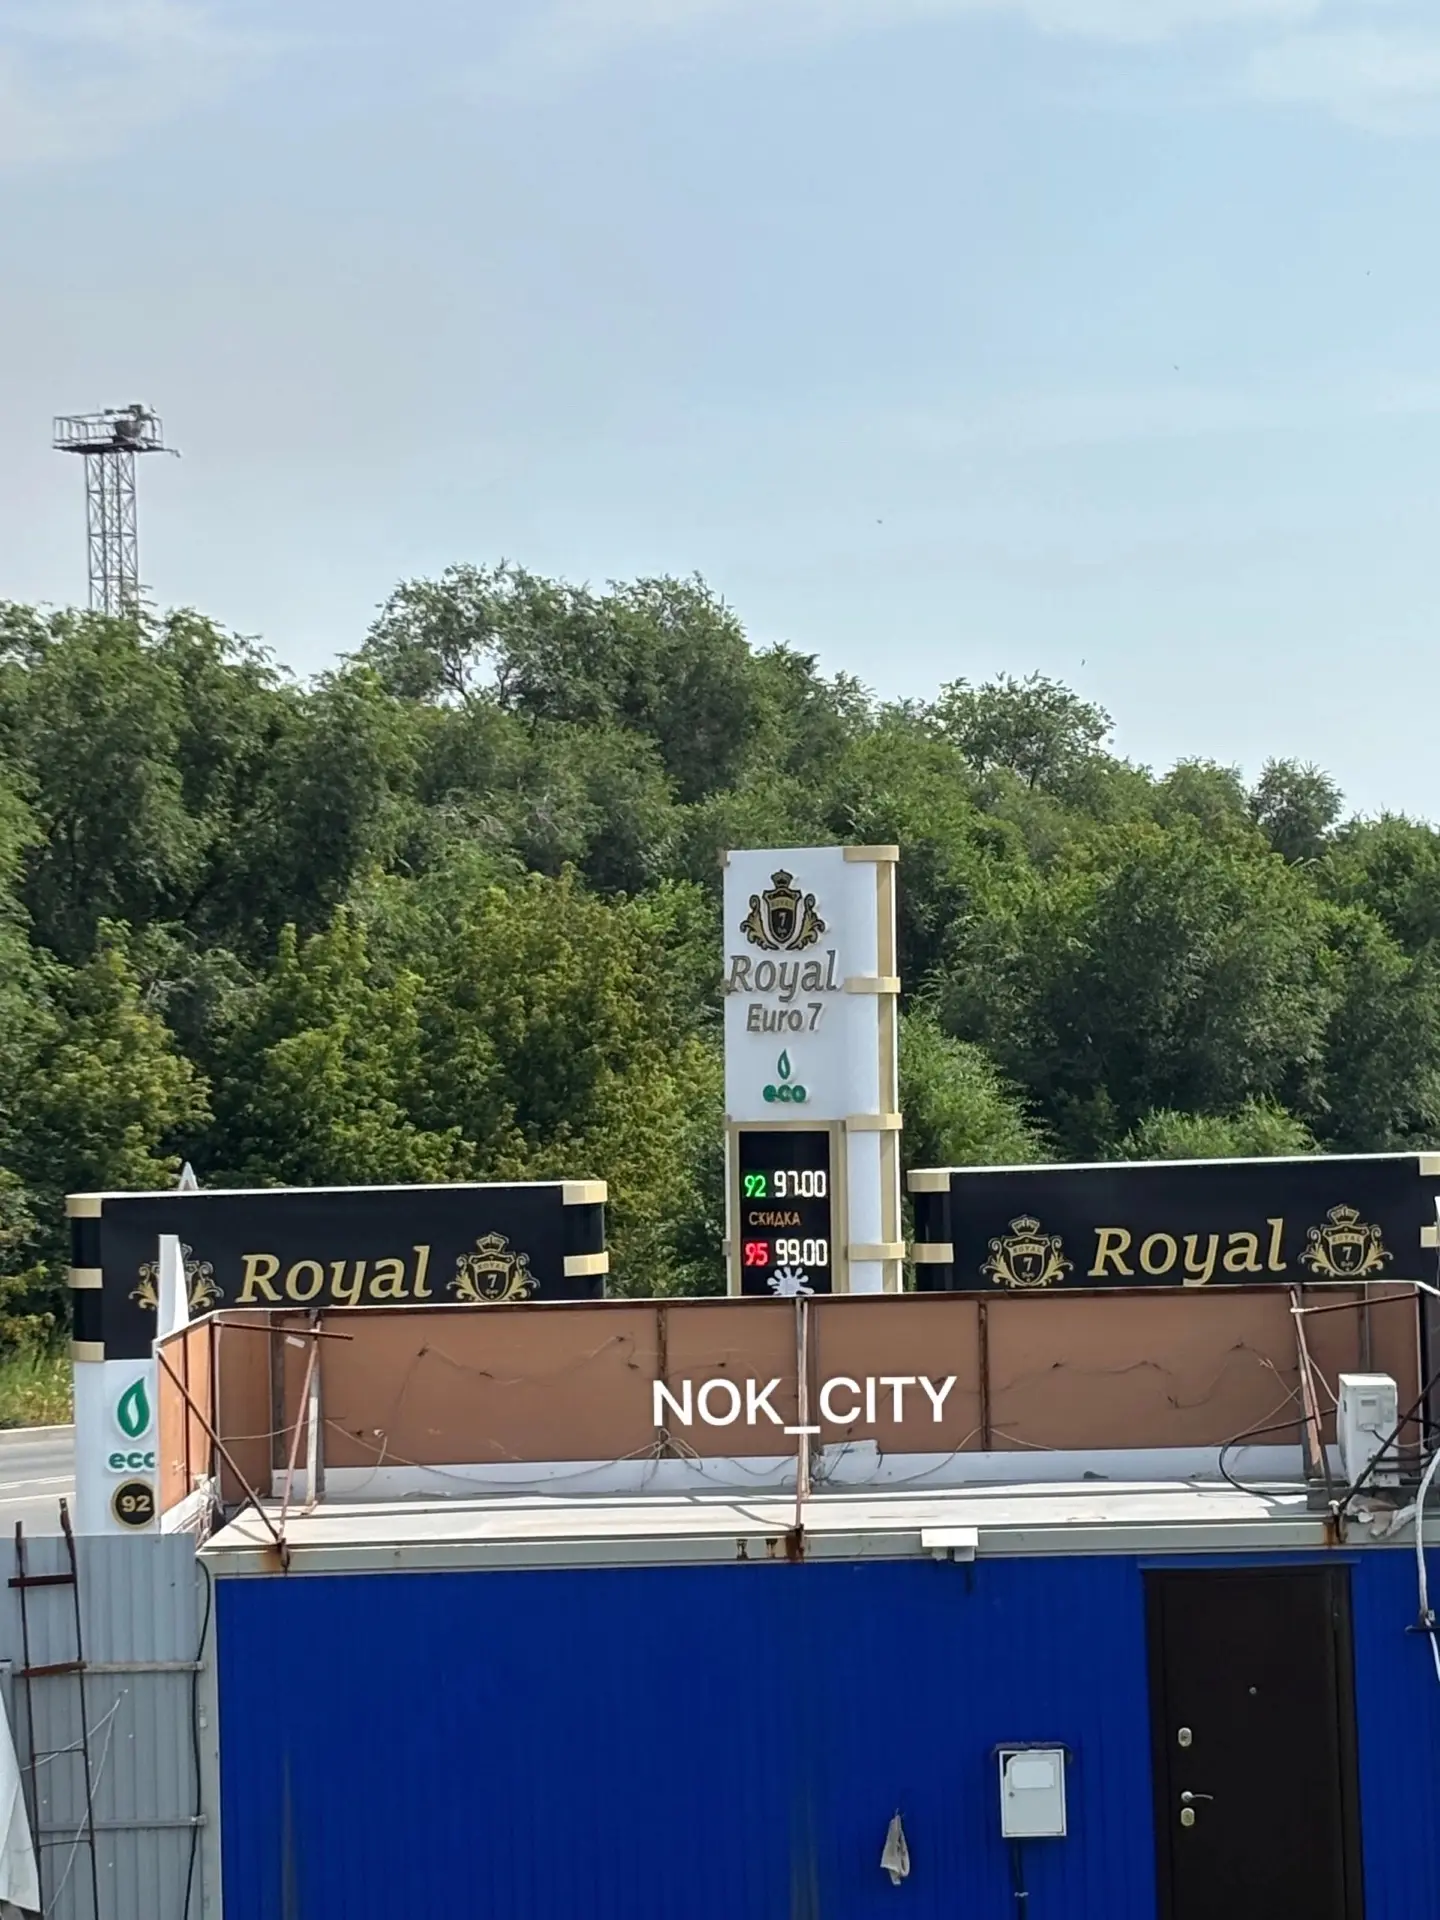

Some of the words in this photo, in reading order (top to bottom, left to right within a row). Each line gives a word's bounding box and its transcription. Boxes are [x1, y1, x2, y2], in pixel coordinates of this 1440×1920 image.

[778, 912, 788, 928] 7
[729, 950, 838, 1003] Royal
[746, 1004, 803, 1033] Euro
[806, 1003, 823, 1031] 7
[762, 1084, 807, 1103] eco
[744, 1174, 767, 1198] 92
[748, 1211, 801, 1227] СКИДКА
[745, 1242, 768, 1266] 95
[775, 1239, 828, 1266] 99.00
[1087, 1218, 1287, 1287] Royal
[1341, 1246, 1352, 1261] 7
[1022, 1256, 1033, 1271] 7
[234, 1245, 433, 1306] Royal
[487, 1273, 498, 1288] 7
[121, 1494, 152, 1512] 92
